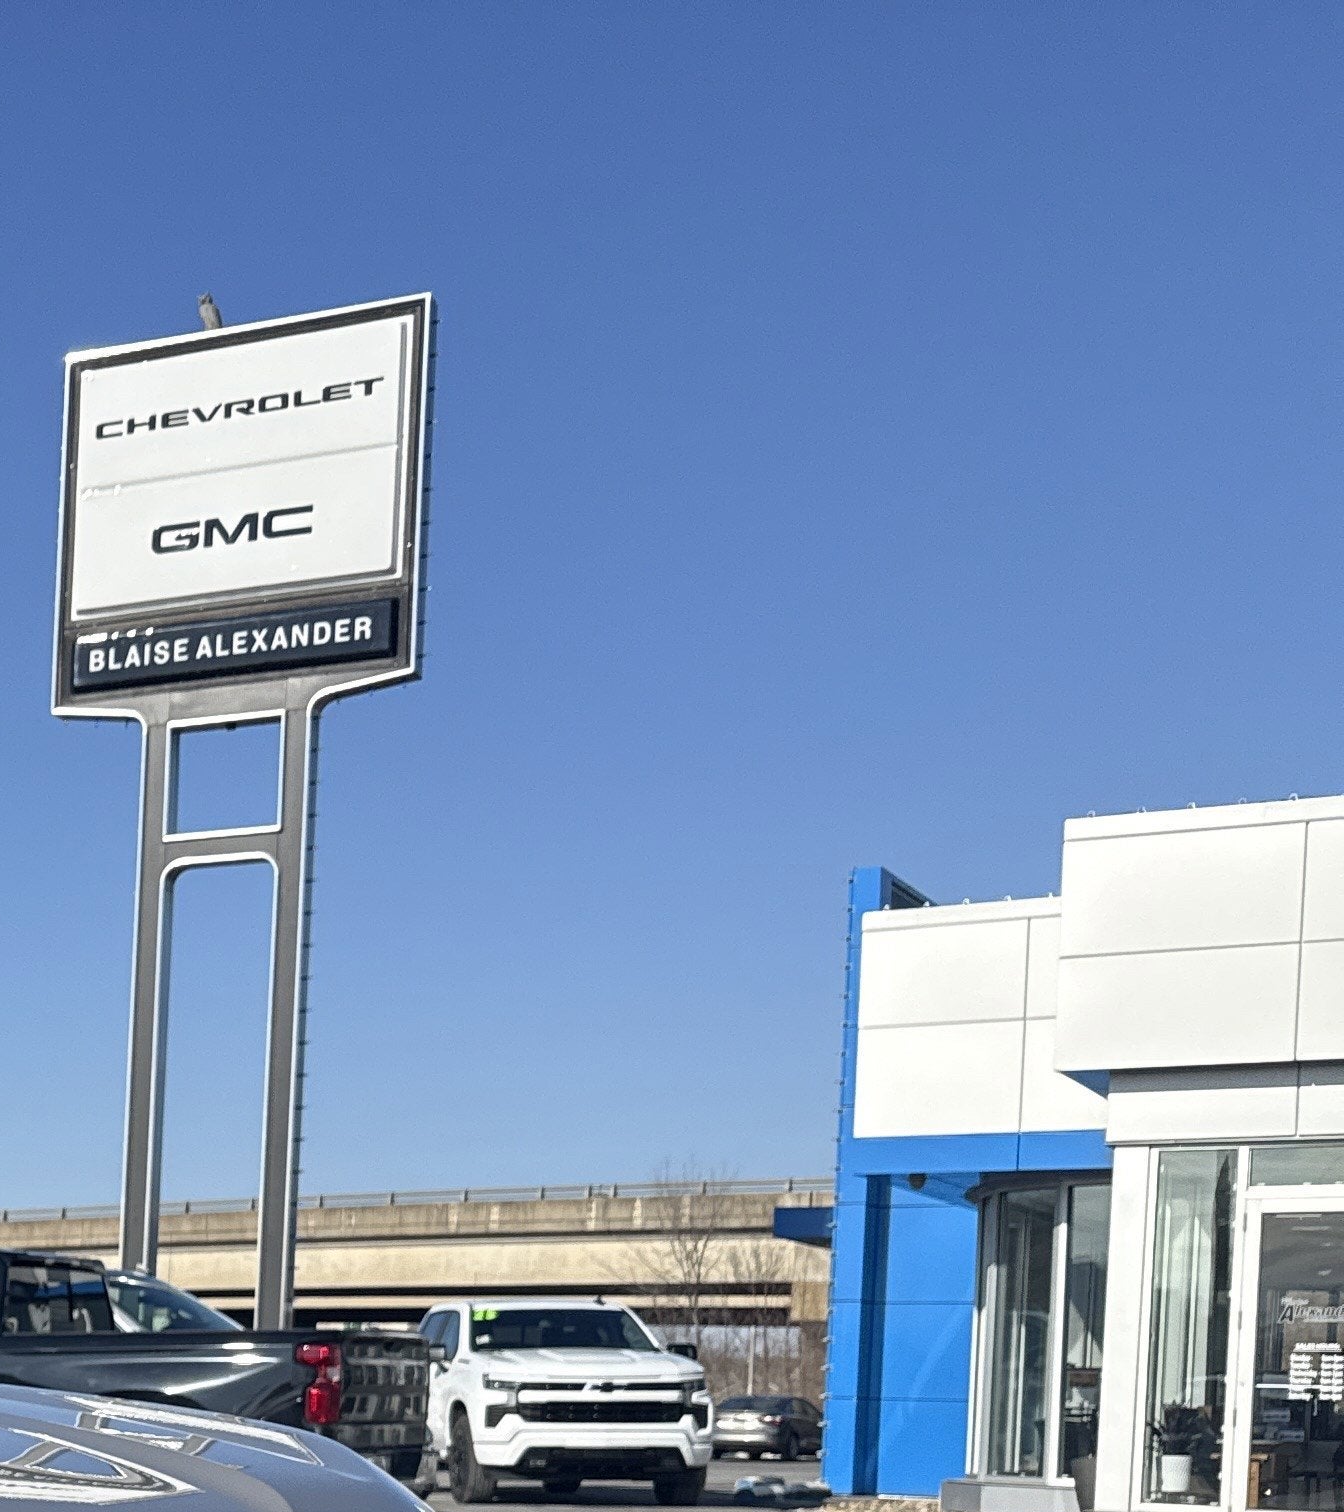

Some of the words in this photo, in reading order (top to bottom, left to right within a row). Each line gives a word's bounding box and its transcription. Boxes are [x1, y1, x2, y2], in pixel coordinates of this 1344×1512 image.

[95, 376, 385, 440] CHEVROLET
[151, 504, 314, 555] GMC
[88, 638, 190, 673] BLAISE
[195, 616, 373, 660] ALEXANDER
